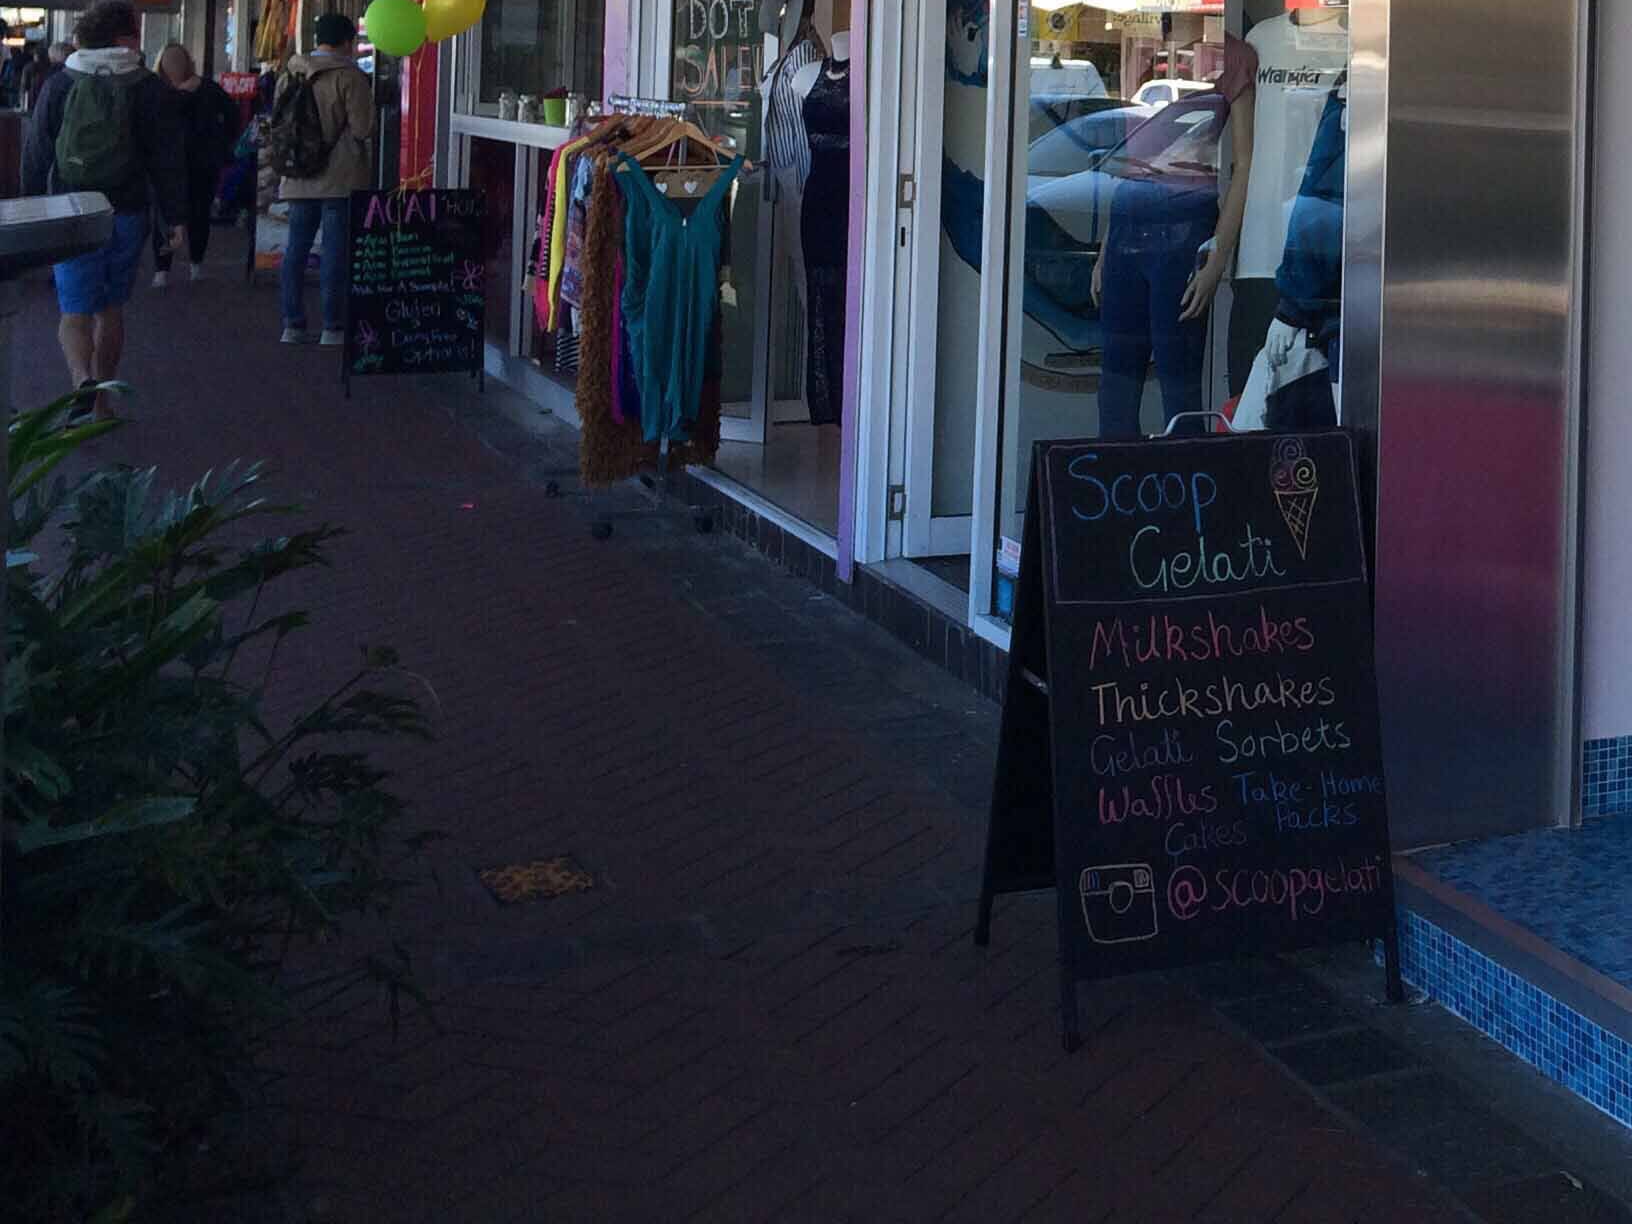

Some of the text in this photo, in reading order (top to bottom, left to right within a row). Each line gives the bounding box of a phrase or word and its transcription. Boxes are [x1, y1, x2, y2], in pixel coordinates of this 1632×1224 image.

[1068, 453, 1217, 534] Scoop
[1130, 523, 1287, 591] Gelati
[1089, 607, 1314, 671] Milkshakes
[1089, 676, 1336, 725] Thickshakes
[1090, 719, 1351, 776] Gelati Sorbets
[1099, 776, 1218, 825] Waffles
